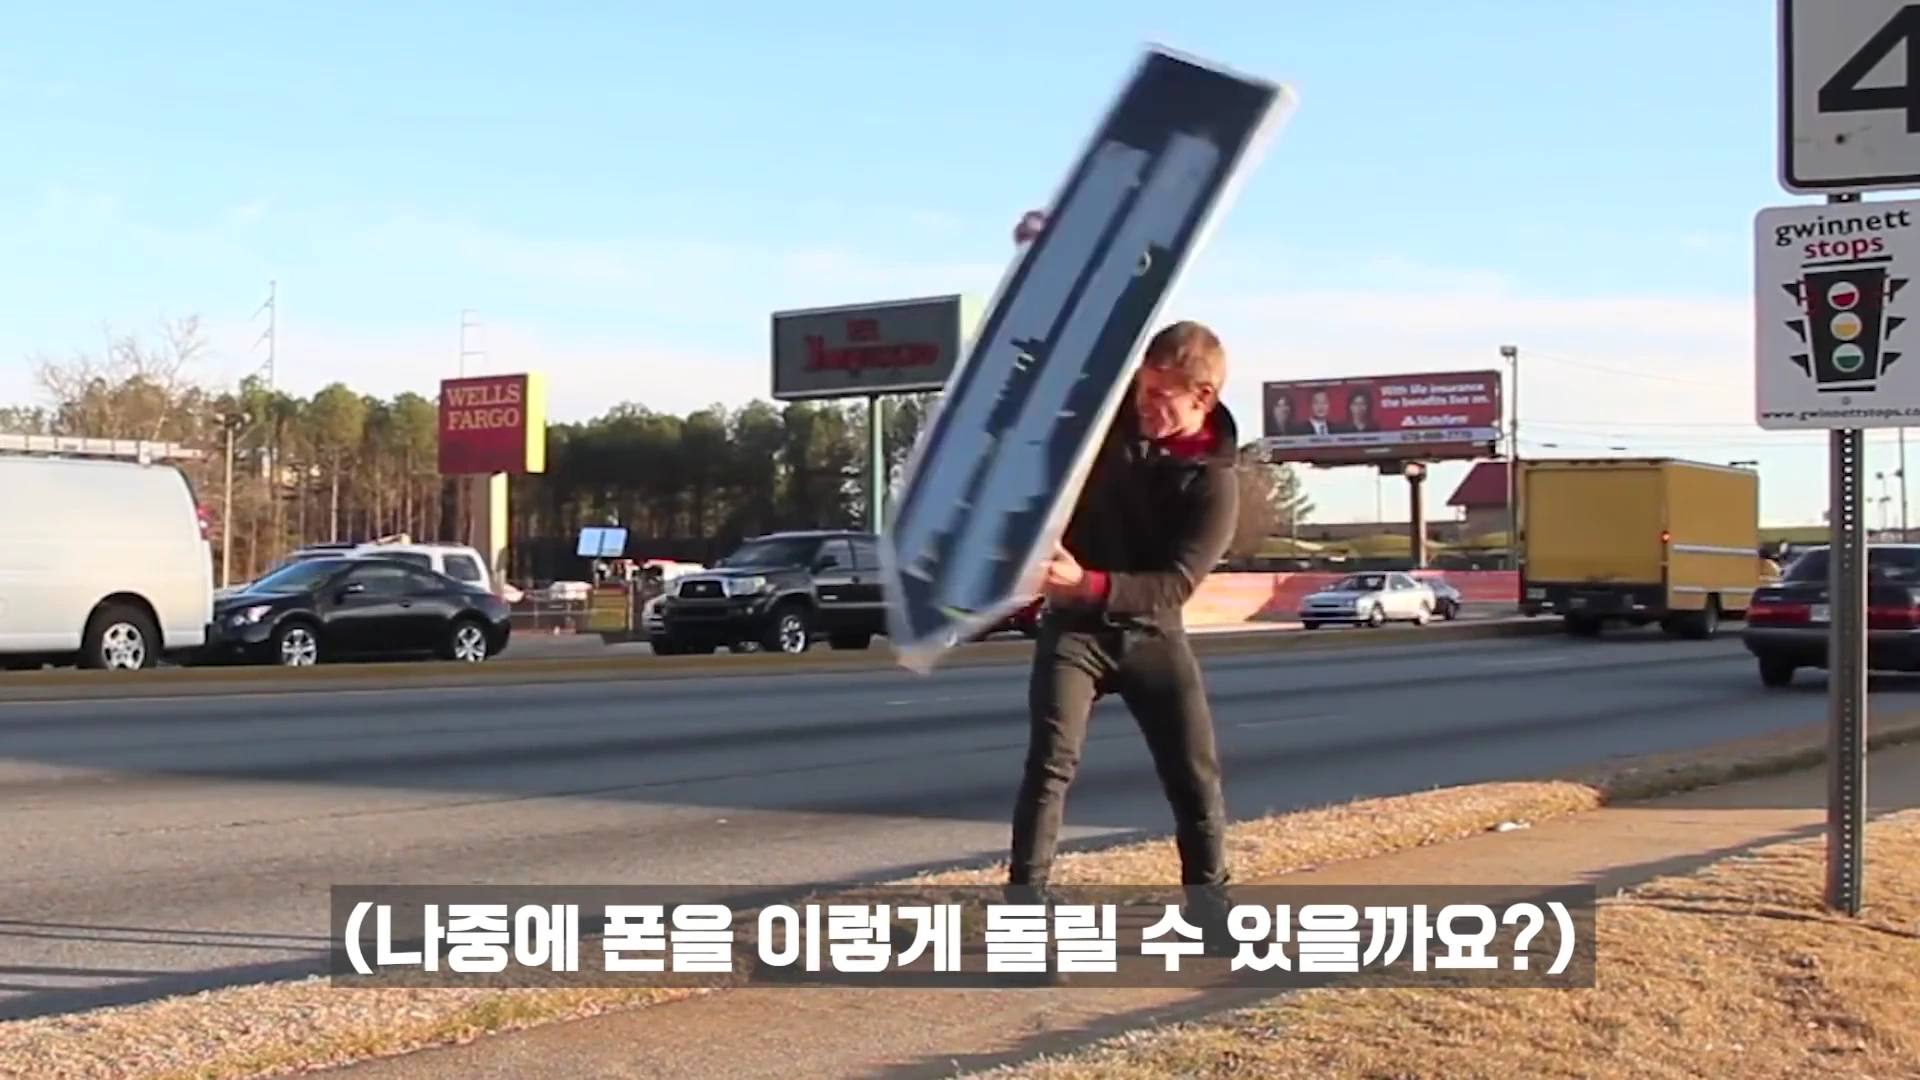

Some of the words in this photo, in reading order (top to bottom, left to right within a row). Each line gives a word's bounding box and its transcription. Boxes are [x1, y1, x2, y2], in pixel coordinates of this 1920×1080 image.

[1818, 4, 1920, 133] 4
[1775, 209, 1911, 246] gwinnett
[1804, 237, 1884, 261] stops
[446, 383, 520, 407] WELLS
[447, 407, 520, 430] FARGO
